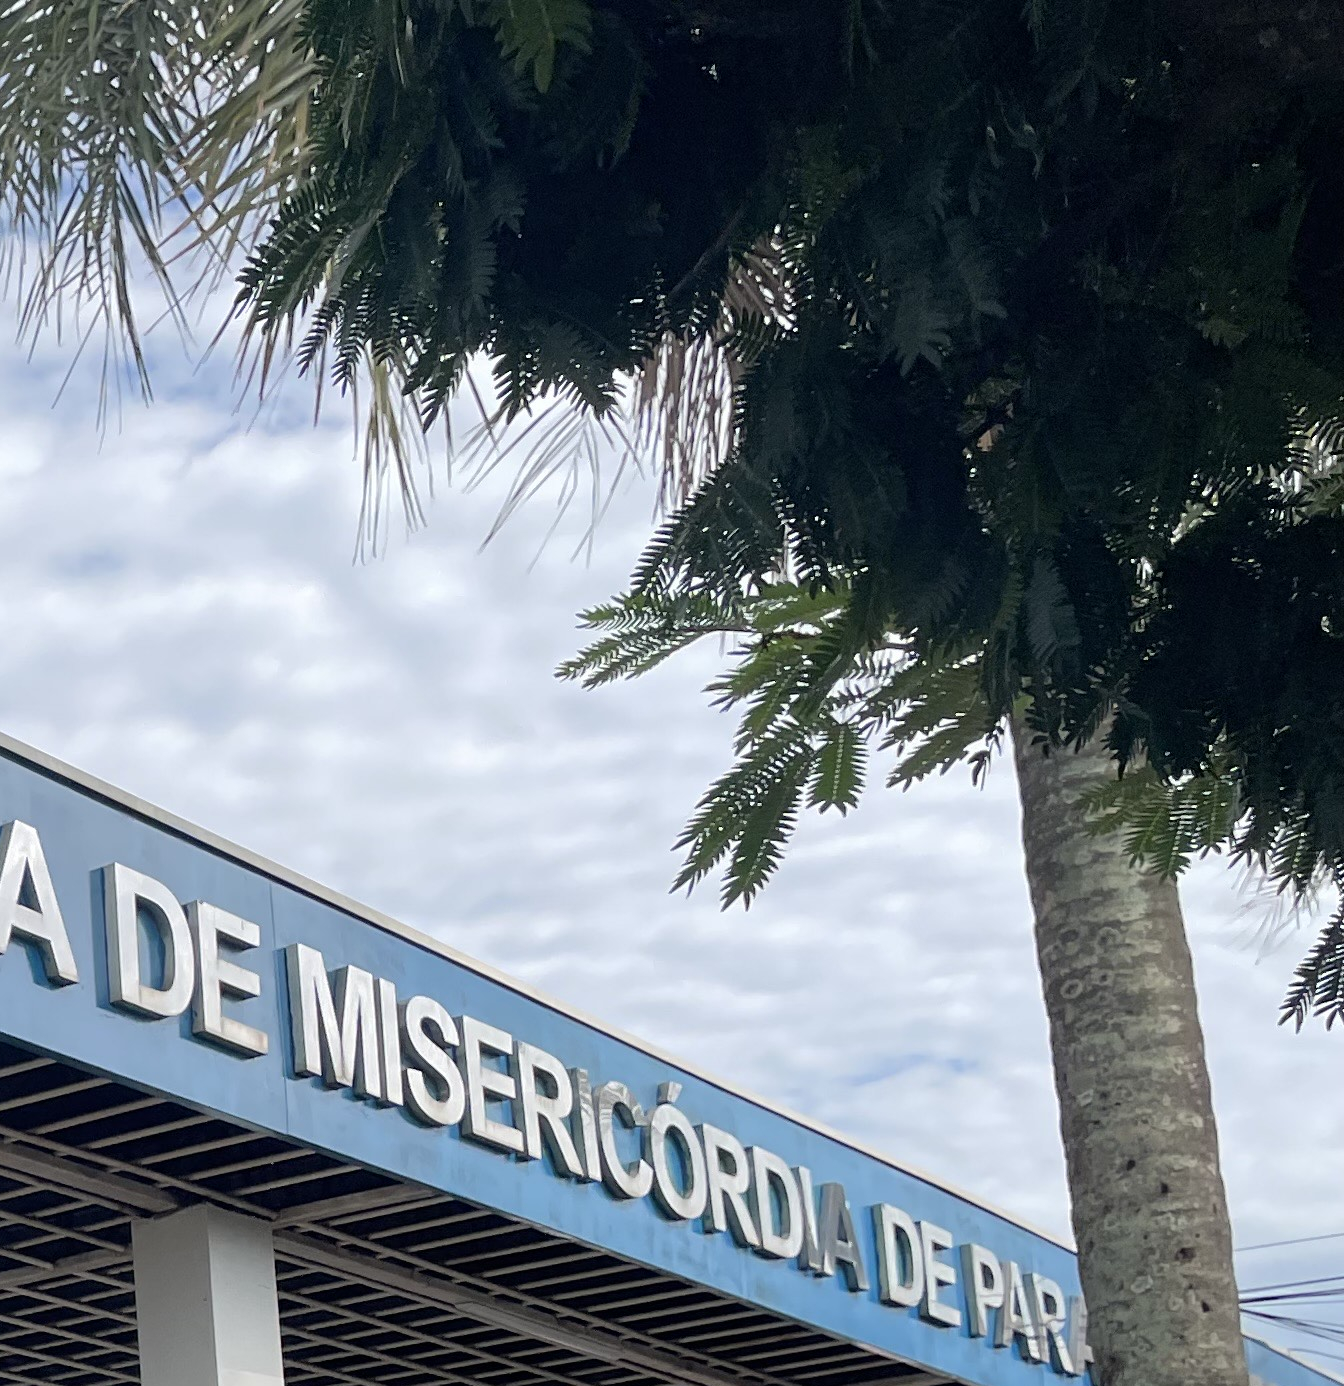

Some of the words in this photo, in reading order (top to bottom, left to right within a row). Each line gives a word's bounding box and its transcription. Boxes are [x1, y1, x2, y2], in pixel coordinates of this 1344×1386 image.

[102, 862, 268, 1060] DE
[286, 943, 868, 1293] MISERICÓRDIA
[871, 1203, 961, 1327] DE
